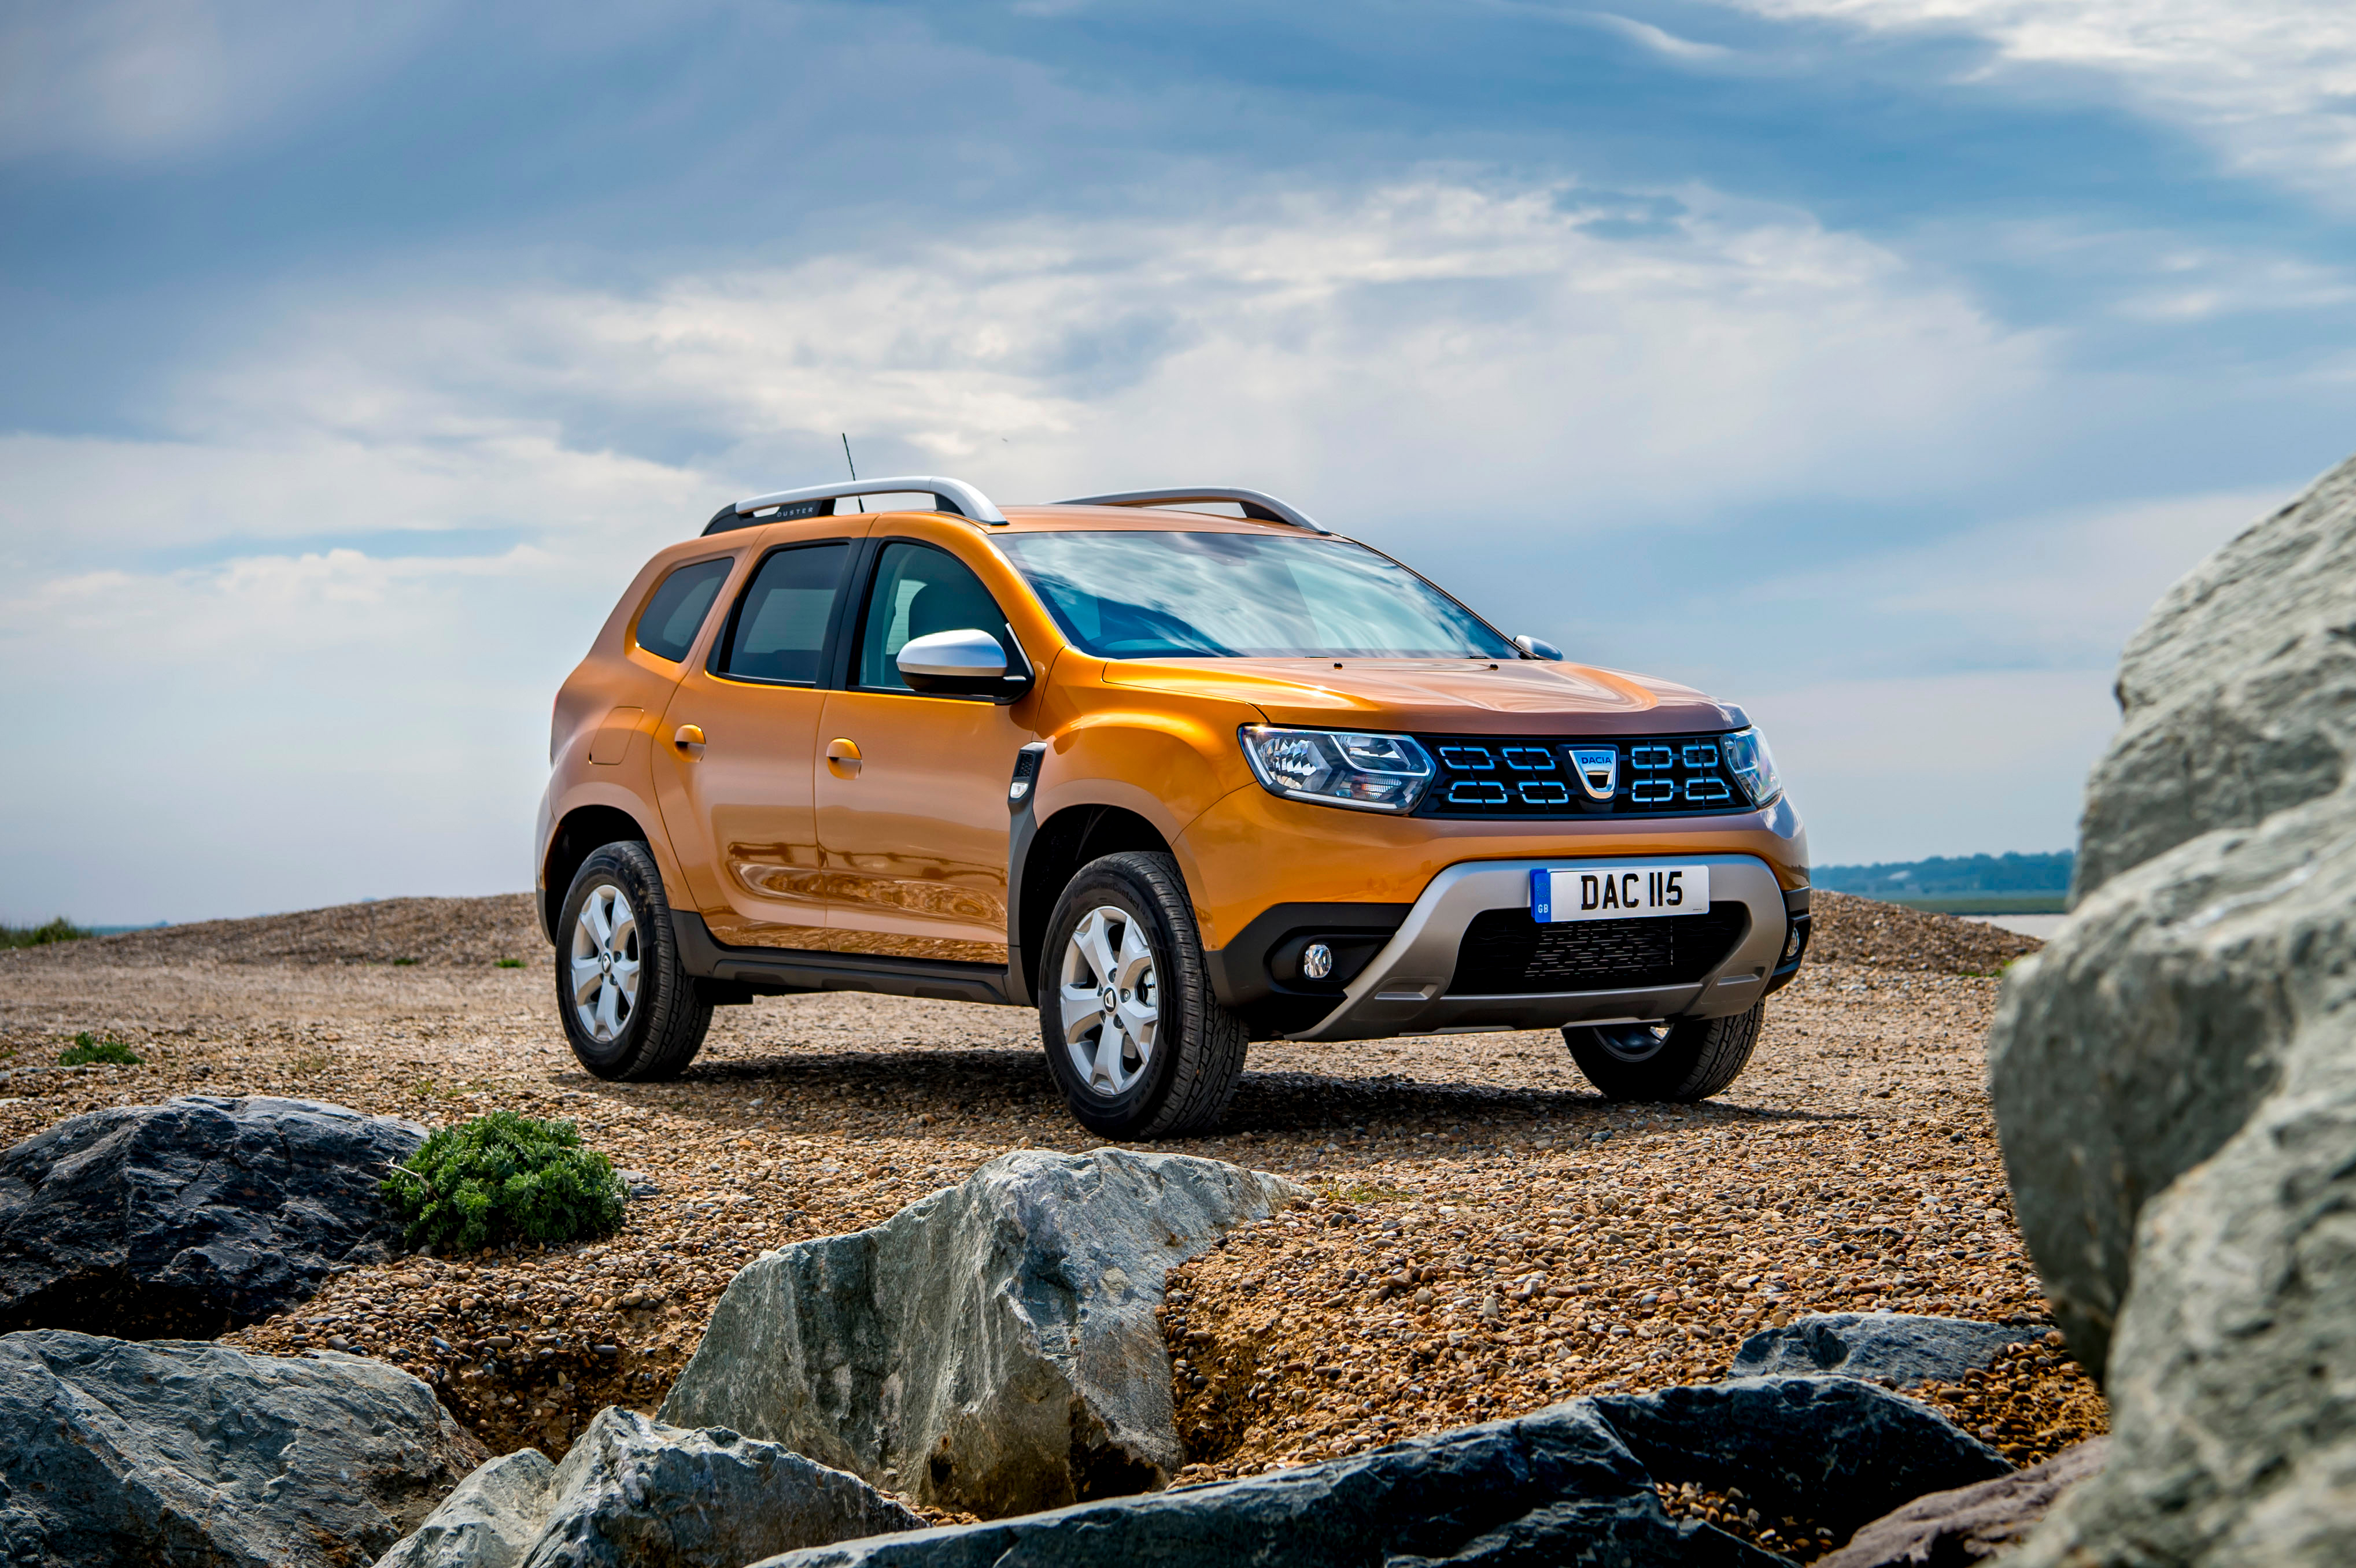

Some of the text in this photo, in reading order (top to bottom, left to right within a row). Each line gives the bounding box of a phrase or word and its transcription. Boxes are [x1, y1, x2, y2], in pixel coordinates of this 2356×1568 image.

[777, 507, 813, 517] DUSTER
[1581, 871, 1683, 910] DAC 115
[1538, 904, 1549, 914] GB
